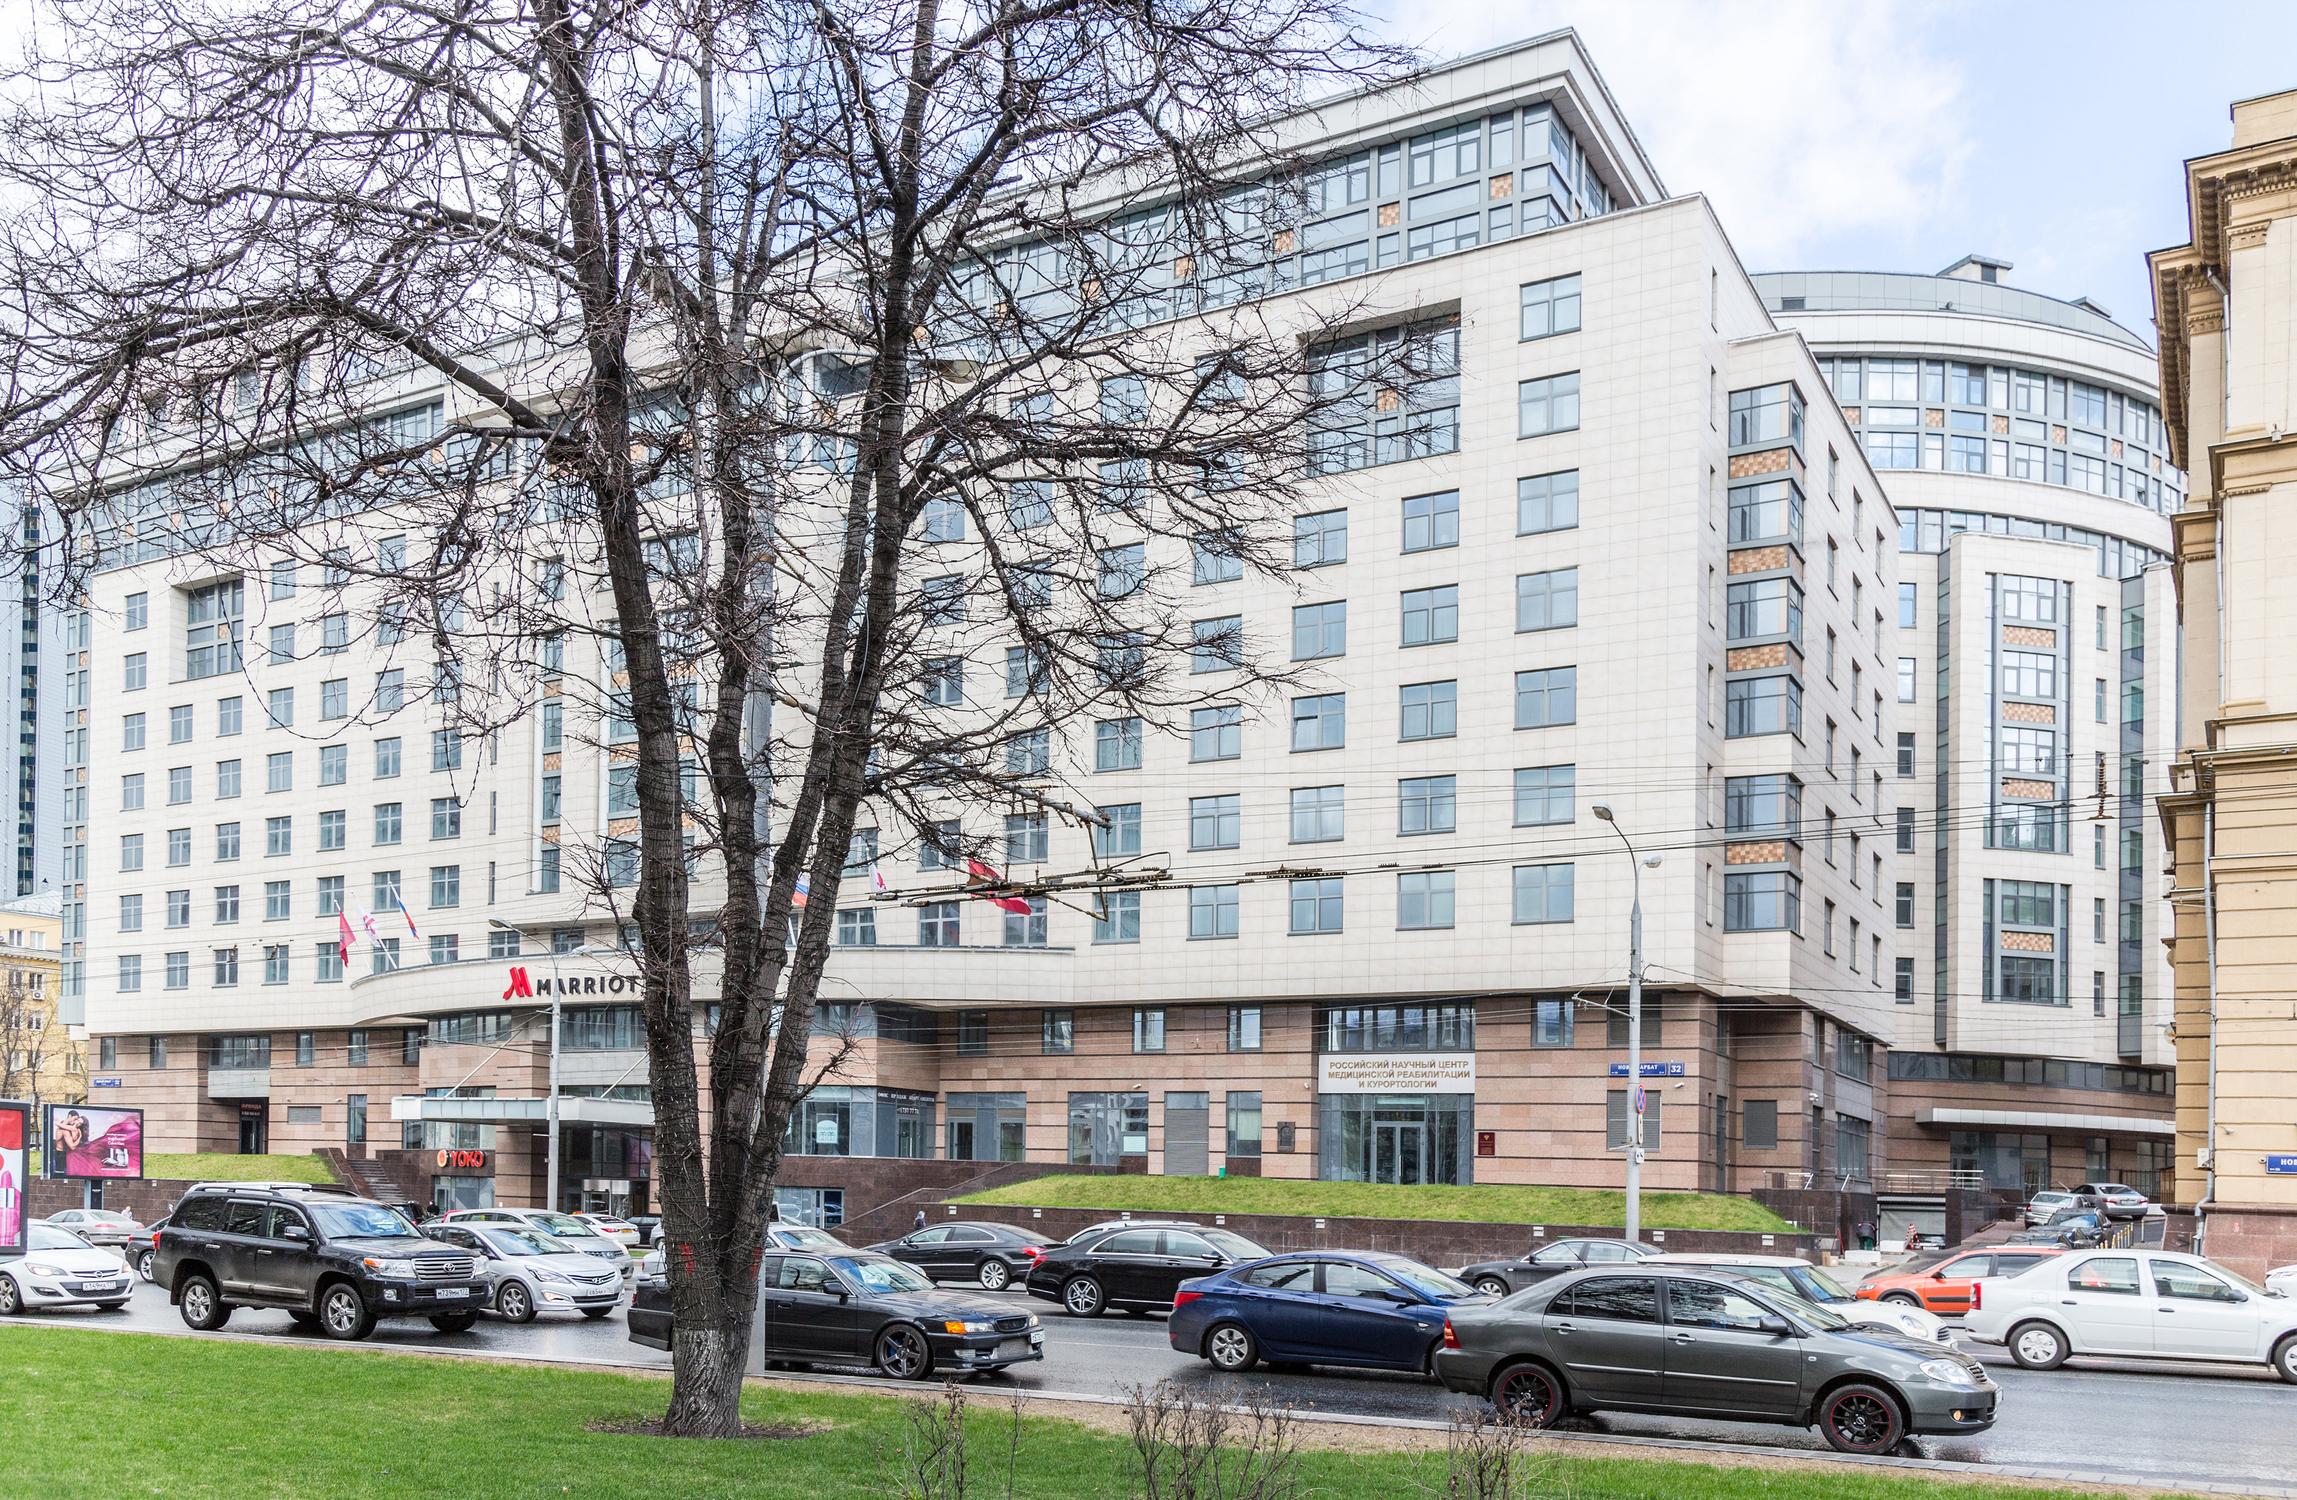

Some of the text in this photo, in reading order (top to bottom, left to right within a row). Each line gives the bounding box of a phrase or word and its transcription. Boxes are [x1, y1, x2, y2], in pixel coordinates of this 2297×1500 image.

[536, 975, 647, 996] MARRIOT
[1329, 1060, 1469, 1069] РОССИЙСКИЙ НАУЧНЫЙ ЦЕНТР
[1328, 1070, 1470, 1079] МЕДИЦИНСКОЙ РЕАБИЛИТАЦИИ
[1358, 1080, 1438, 1088] И КУРОРТОЛОГИИ
[450, 1150, 484, 1167] YOKO
